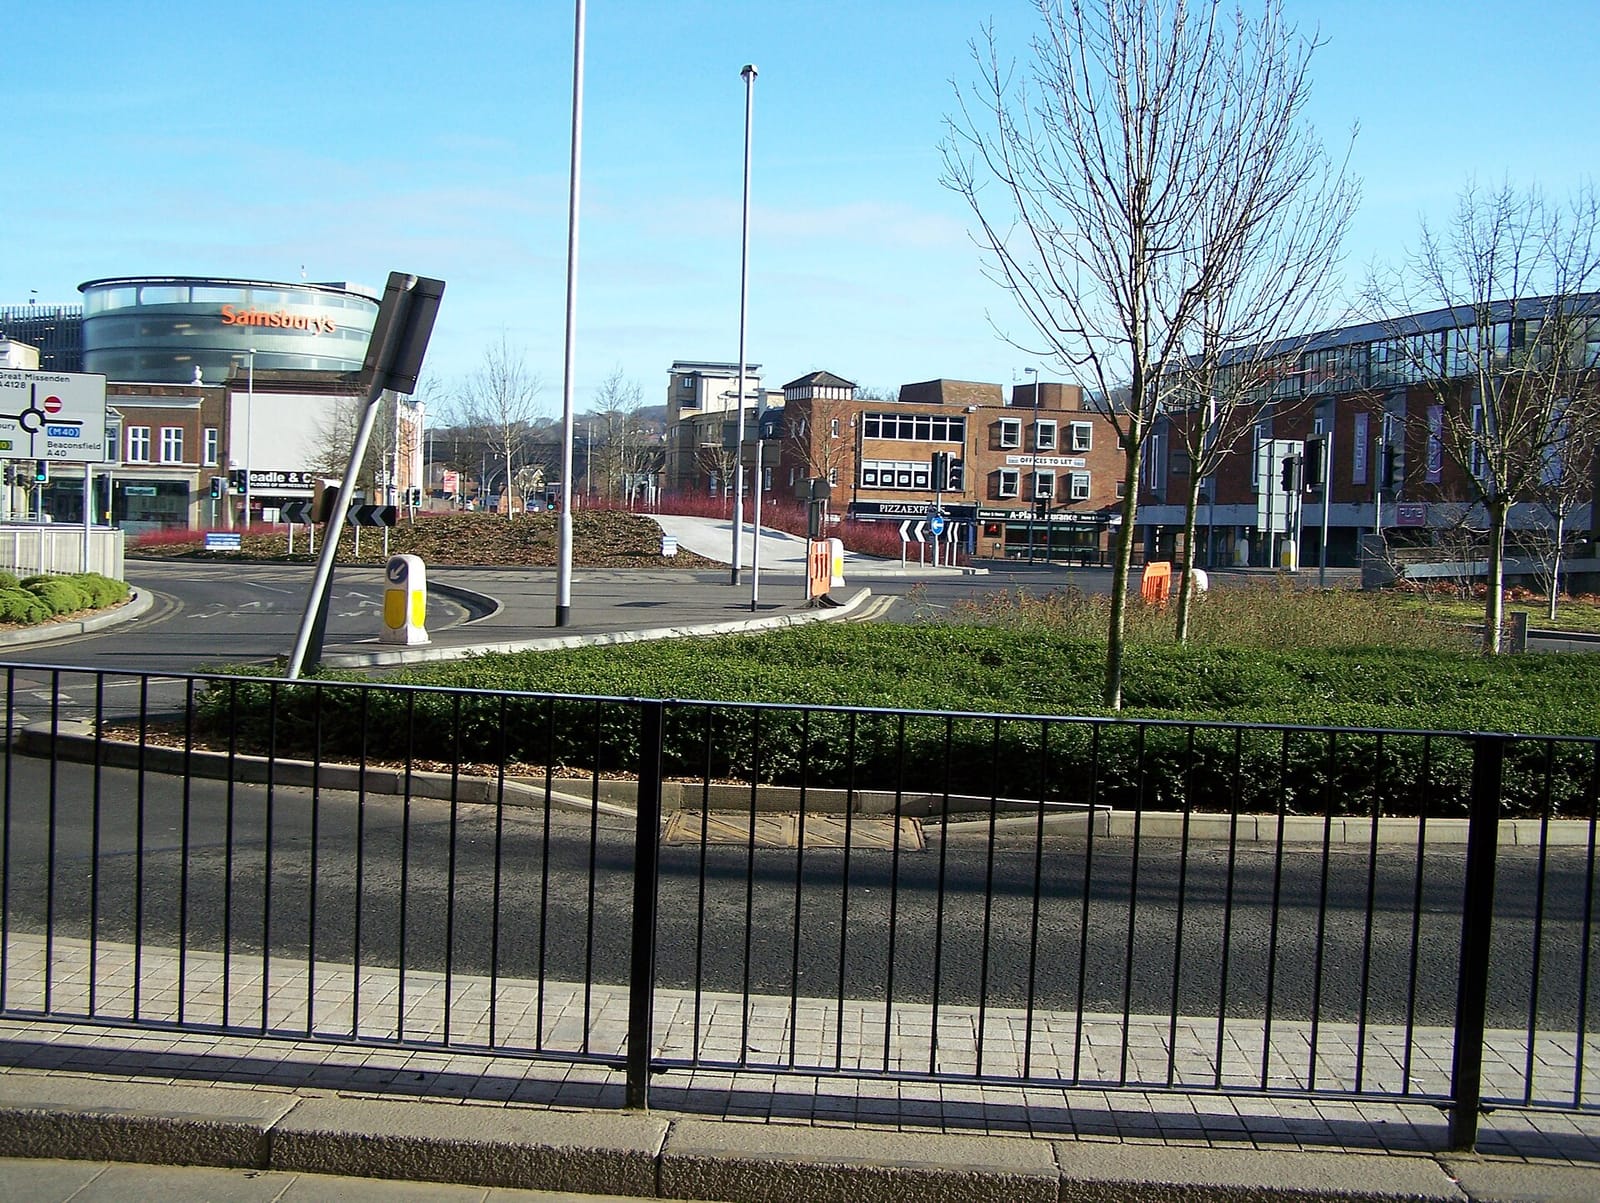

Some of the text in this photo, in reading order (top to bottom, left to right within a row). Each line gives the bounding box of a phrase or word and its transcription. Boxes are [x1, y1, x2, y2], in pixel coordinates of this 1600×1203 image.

[221, 304, 336, 336] Sainsbury's
[25, 374, 70, 382] Missenden
[47, 441, 101, 450] Beaconsfield
[47, 449, 67, 457] A40
[249, 472, 285, 482] eadle
[288, 473, 299, 482] &
